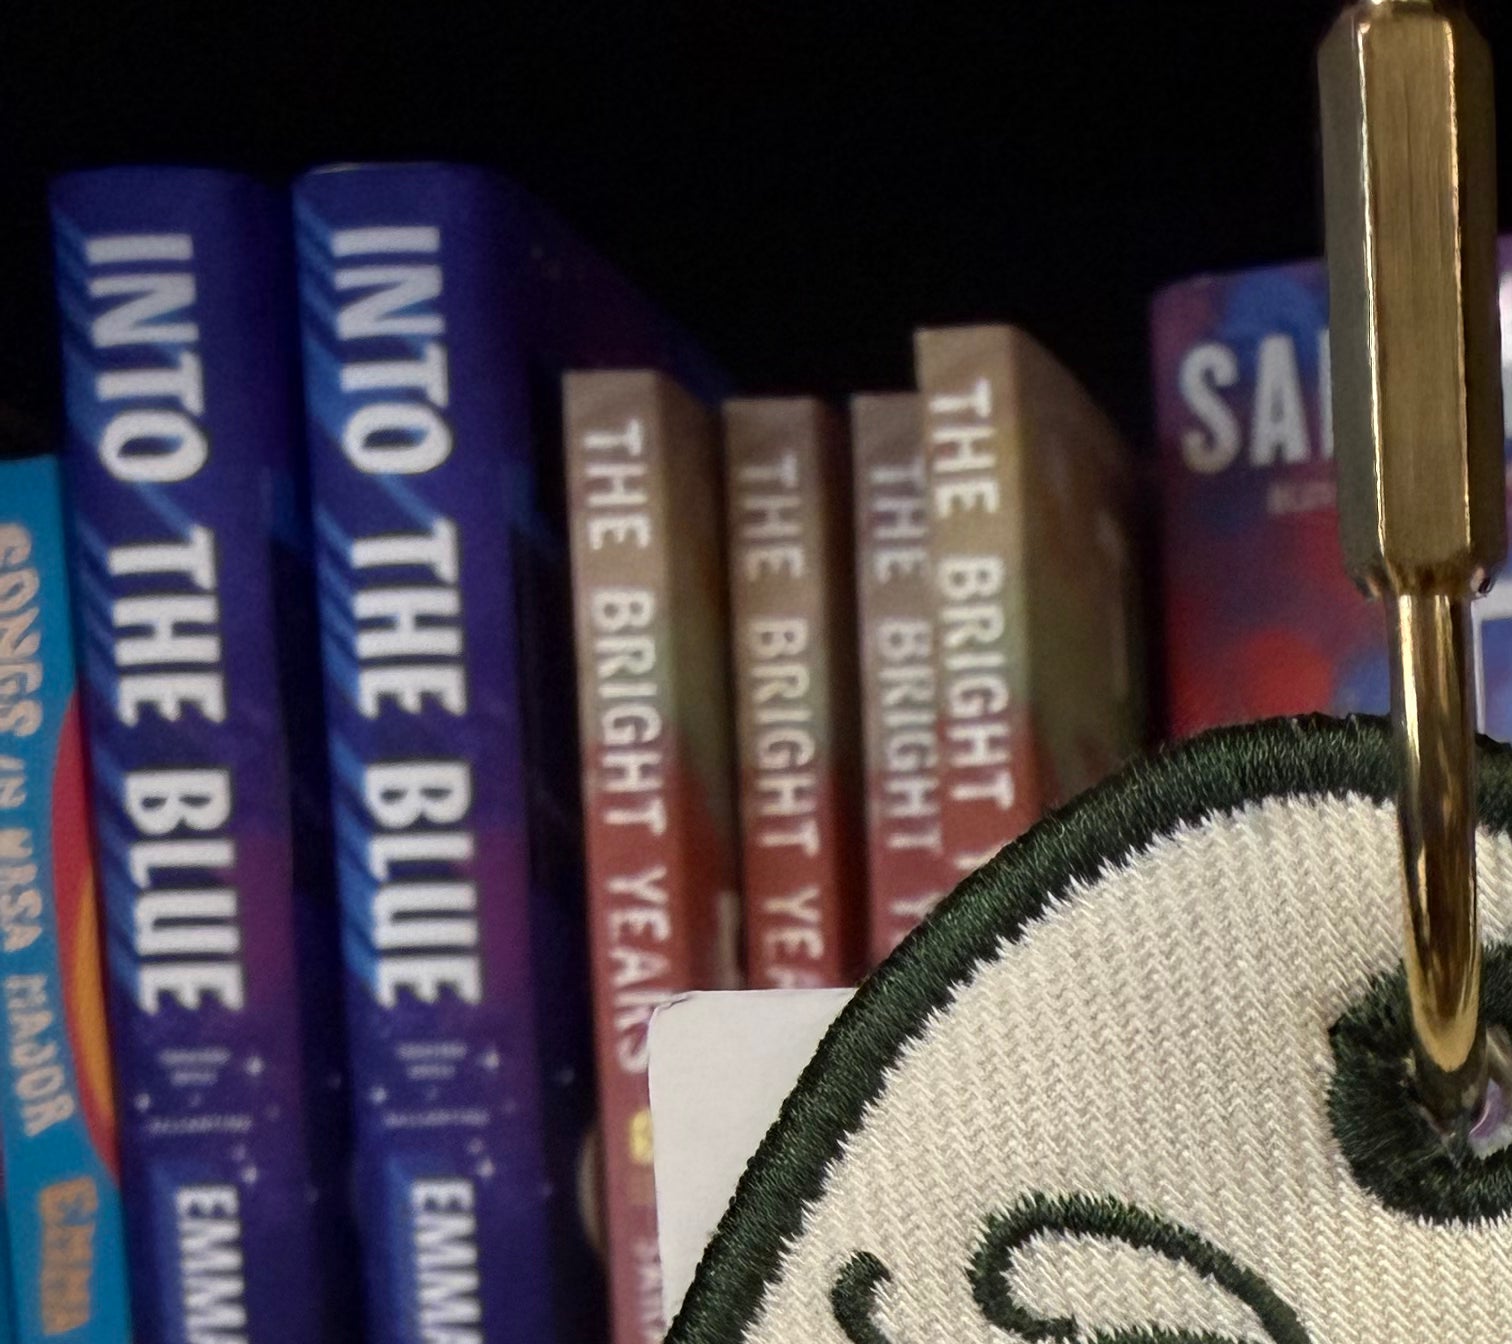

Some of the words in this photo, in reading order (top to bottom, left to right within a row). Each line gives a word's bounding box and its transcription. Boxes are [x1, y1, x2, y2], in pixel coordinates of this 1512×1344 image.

[85, 232, 208, 482] INTO
[330, 225, 454, 476] INTO
[927, 378, 1000, 520] THE
[581, 418, 653, 551] THE
[736, 451, 807, 582] THE
[867, 456, 930, 585] THE
[107, 525, 226, 727] THE
[350, 516, 468, 720] THE
[589, 587, 669, 838] BRIGHT
[876, 617, 943, 854] BRIGHT
[936, 554, 1016, 811] BRIGHT
[745, 617, 823, 859] BRIGHT
[122, 768, 244, 1016] BLUE
[363, 760, 482, 1010] BLUE
[5, 972, 76, 1137] MAJOR
